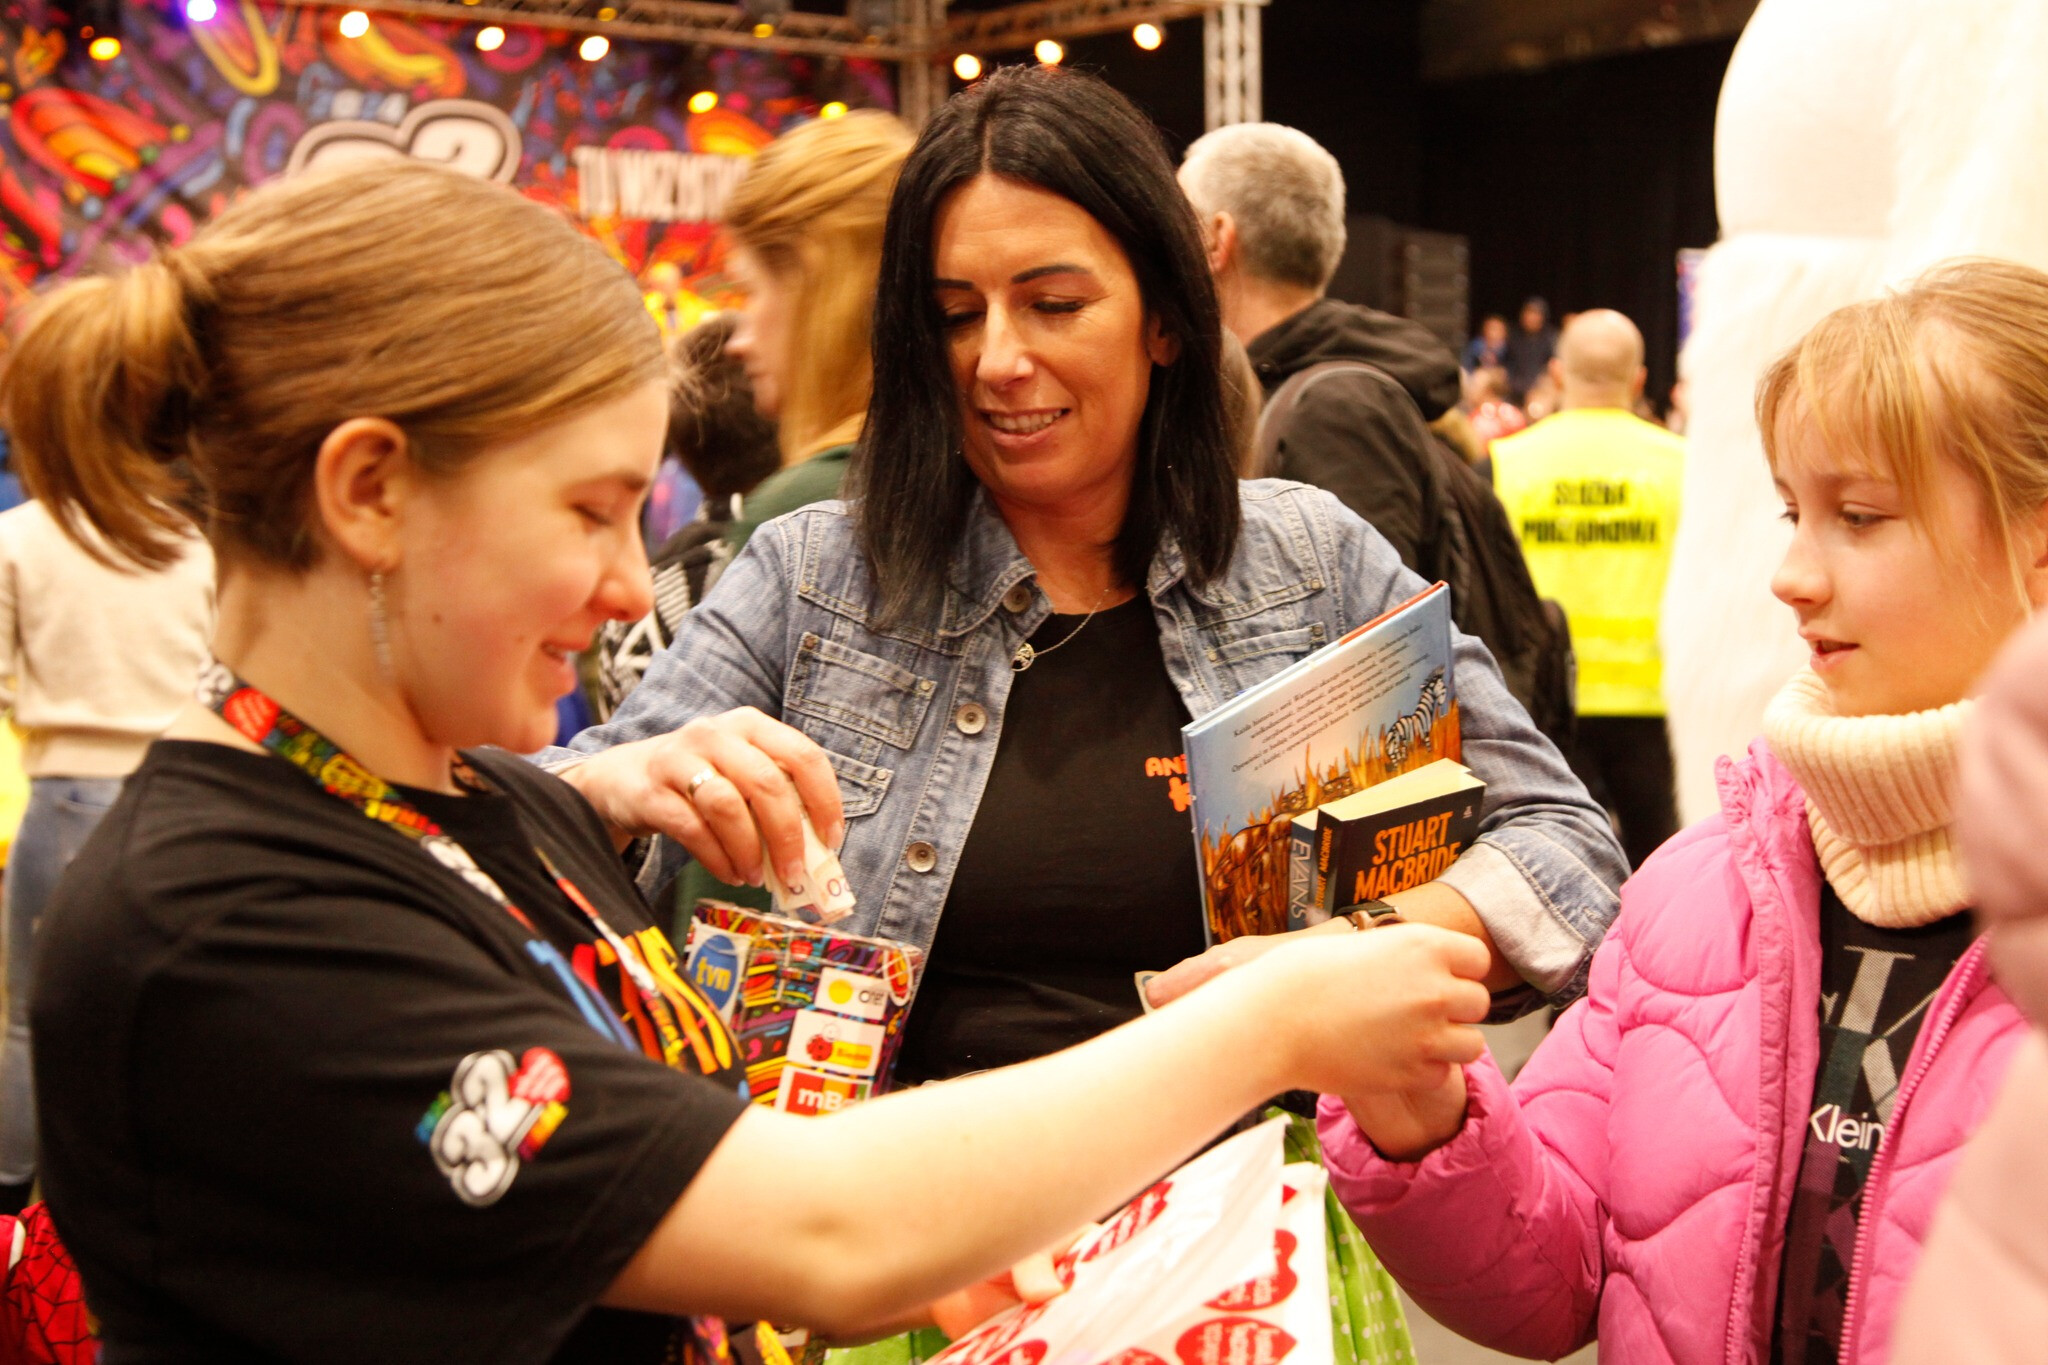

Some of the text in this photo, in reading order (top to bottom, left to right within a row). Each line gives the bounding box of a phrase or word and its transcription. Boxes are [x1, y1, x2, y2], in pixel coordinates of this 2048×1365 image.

[1372, 811, 1453, 865] STUART
[1290, 838, 1312, 919] EVANS
[1353, 841, 1461, 904] MACBRIDE
[696, 956, 732, 992] tvn
